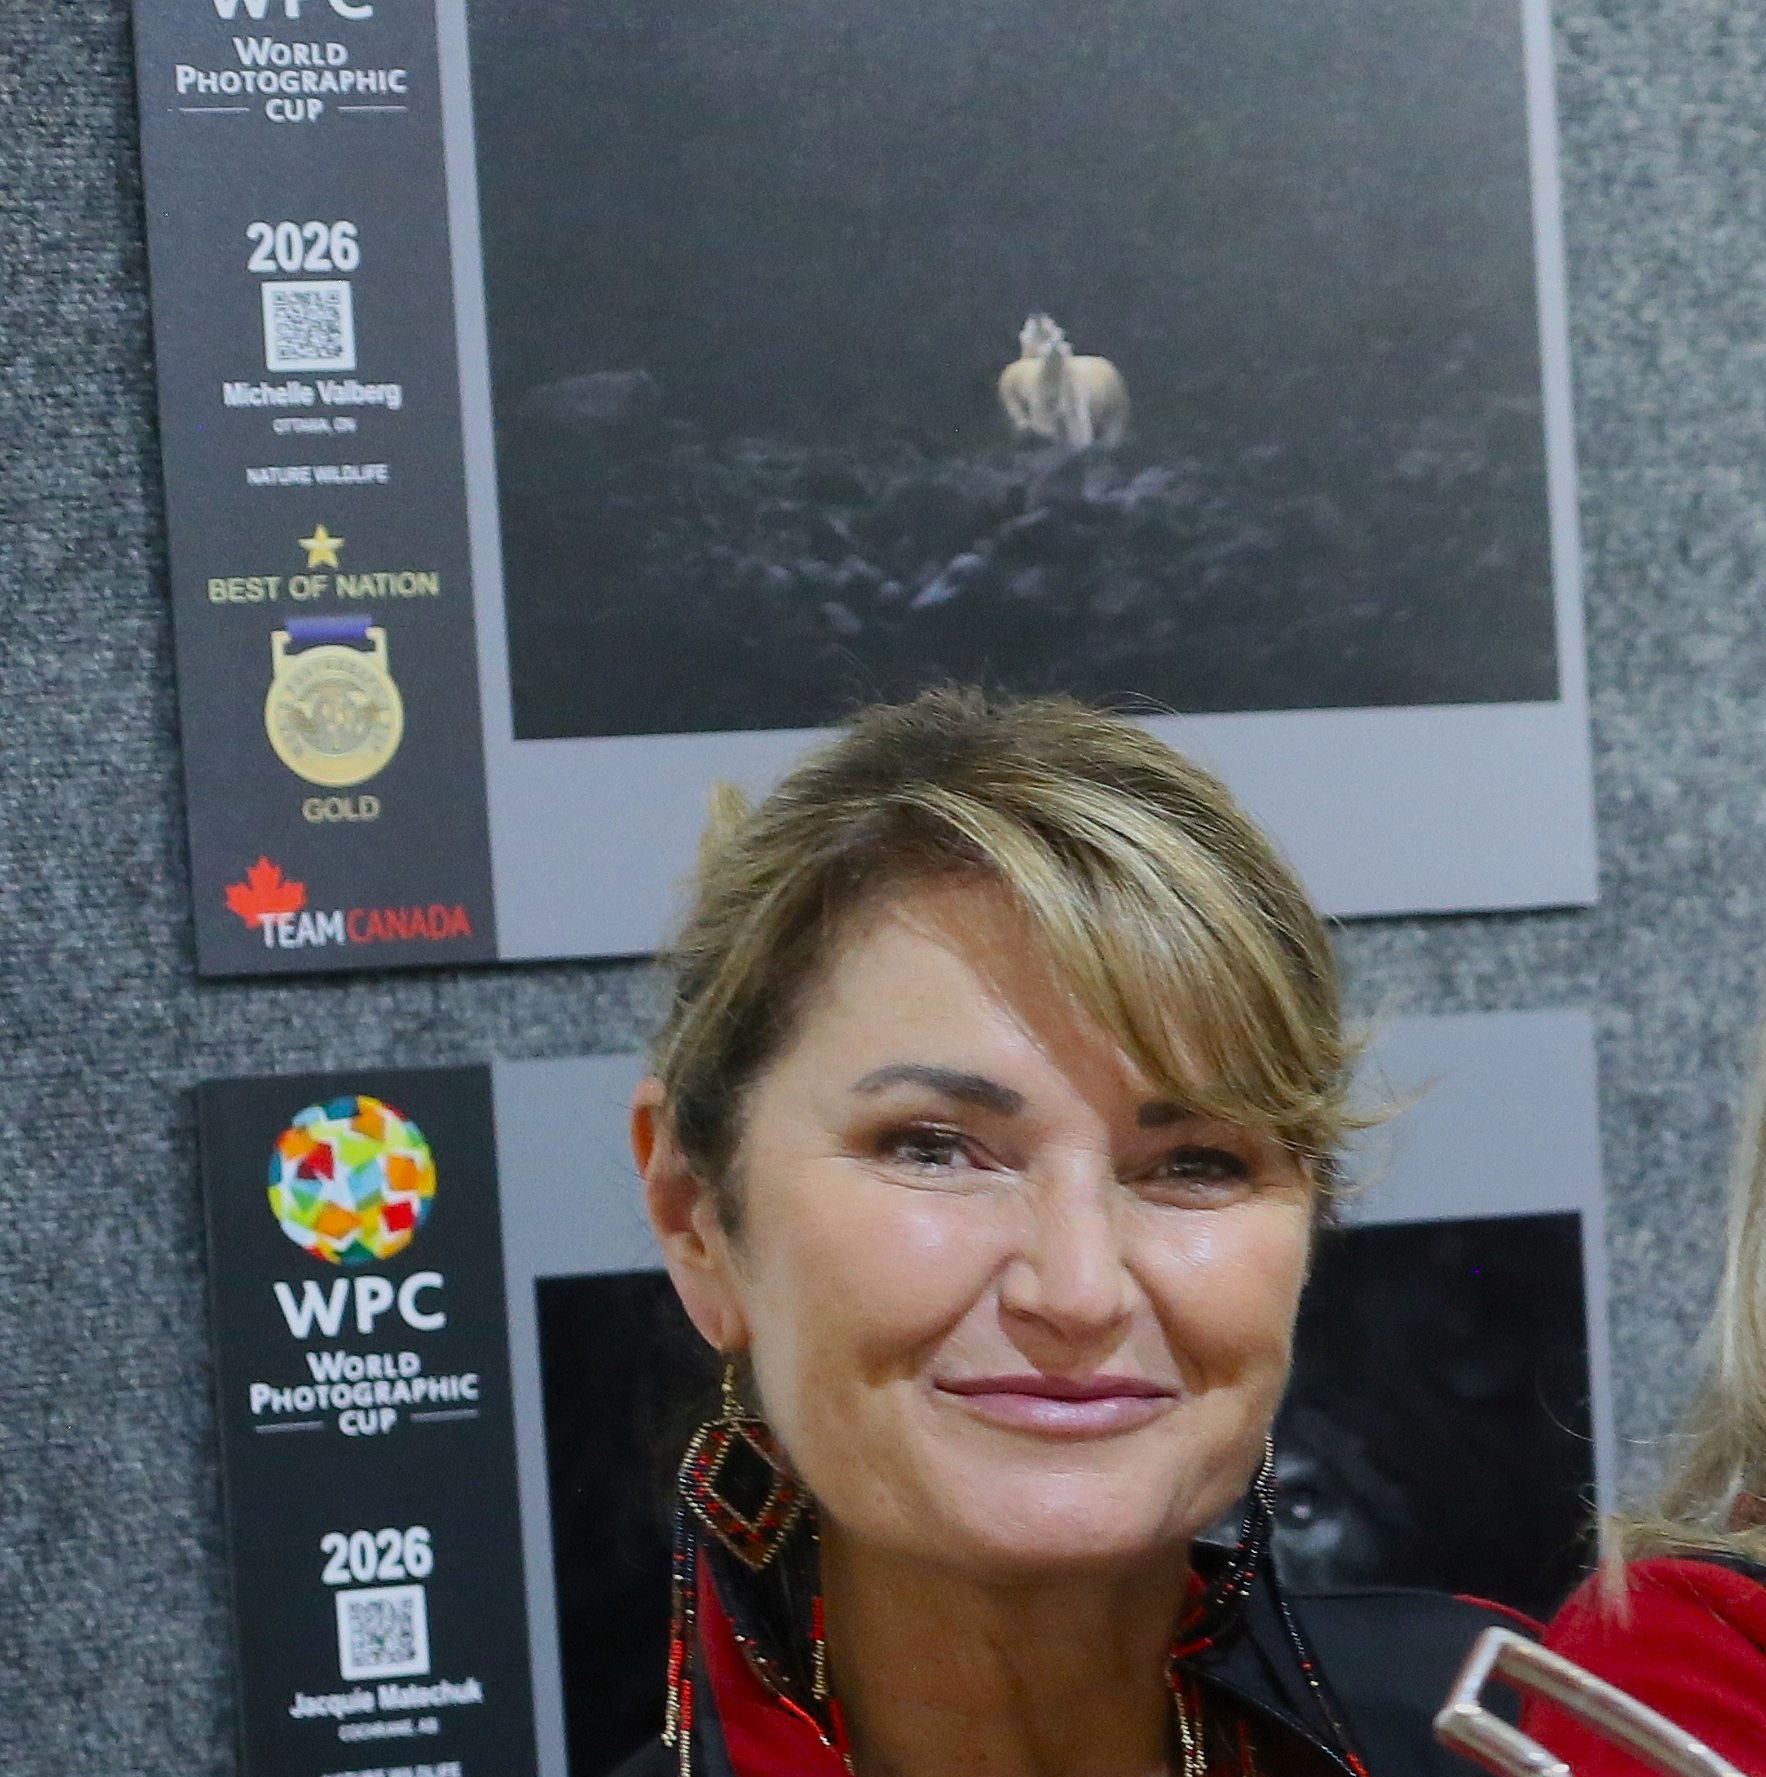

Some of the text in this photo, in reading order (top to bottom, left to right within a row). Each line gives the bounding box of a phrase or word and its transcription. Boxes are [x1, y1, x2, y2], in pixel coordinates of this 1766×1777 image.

[233, 36, 347, 67] WORLD
[175, 65, 408, 94] PHOTOGRAPHIC
[266, 98, 323, 123] CUP
[246, 221, 360, 273] 2026
[208, 571, 439, 602] BEST OF NATION
[302, 795, 381, 824] GOLD
[274, 1272, 447, 1340] WPC
[307, 1351, 421, 1382] WORLD
[250, 1373, 479, 1414] PHOTOGRAPHIC
[339, 1408, 398, 1436] CUP
[320, 1526, 433, 1585] 2026
